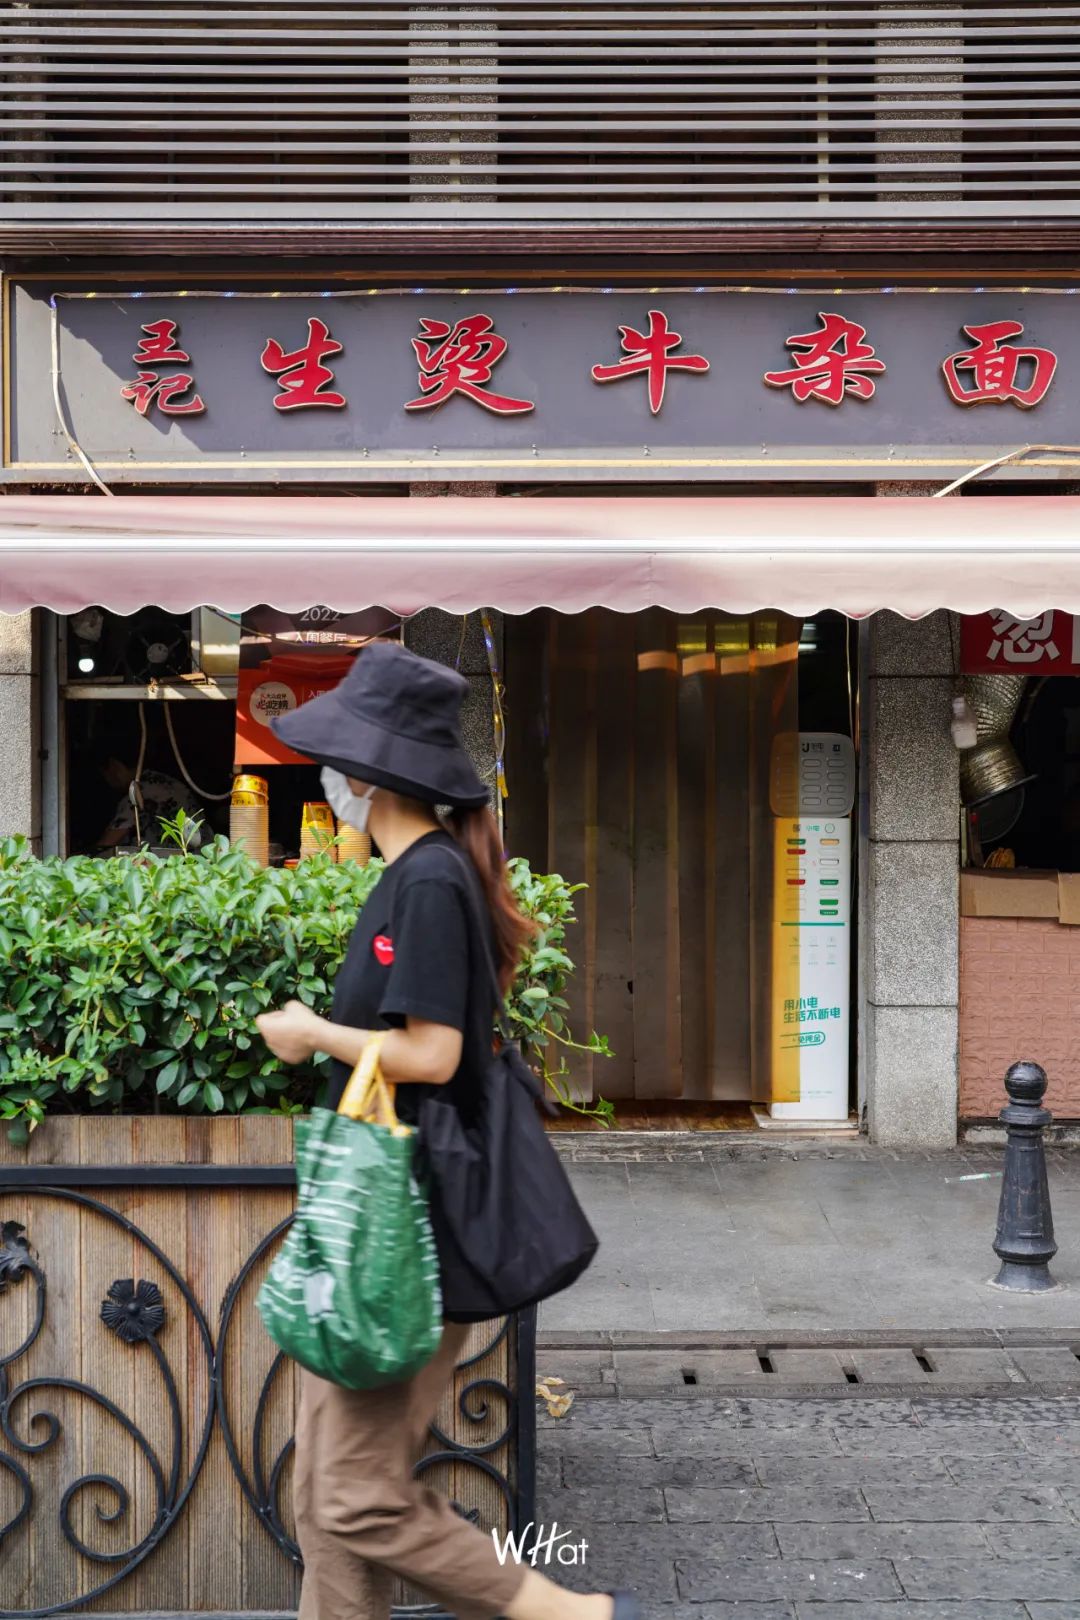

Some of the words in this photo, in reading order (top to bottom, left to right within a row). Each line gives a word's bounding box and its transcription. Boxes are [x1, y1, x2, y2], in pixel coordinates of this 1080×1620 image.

[119, 318, 206, 417] 王记
[260, 310, 1059, 415] 生烫牛杂面
[300, 607, 341, 621] 2022
[295, 631, 347, 644] 入围餐厅
[784, 997, 818, 1011] 用小电
[784, 1007, 841, 1024] 生活不断电
